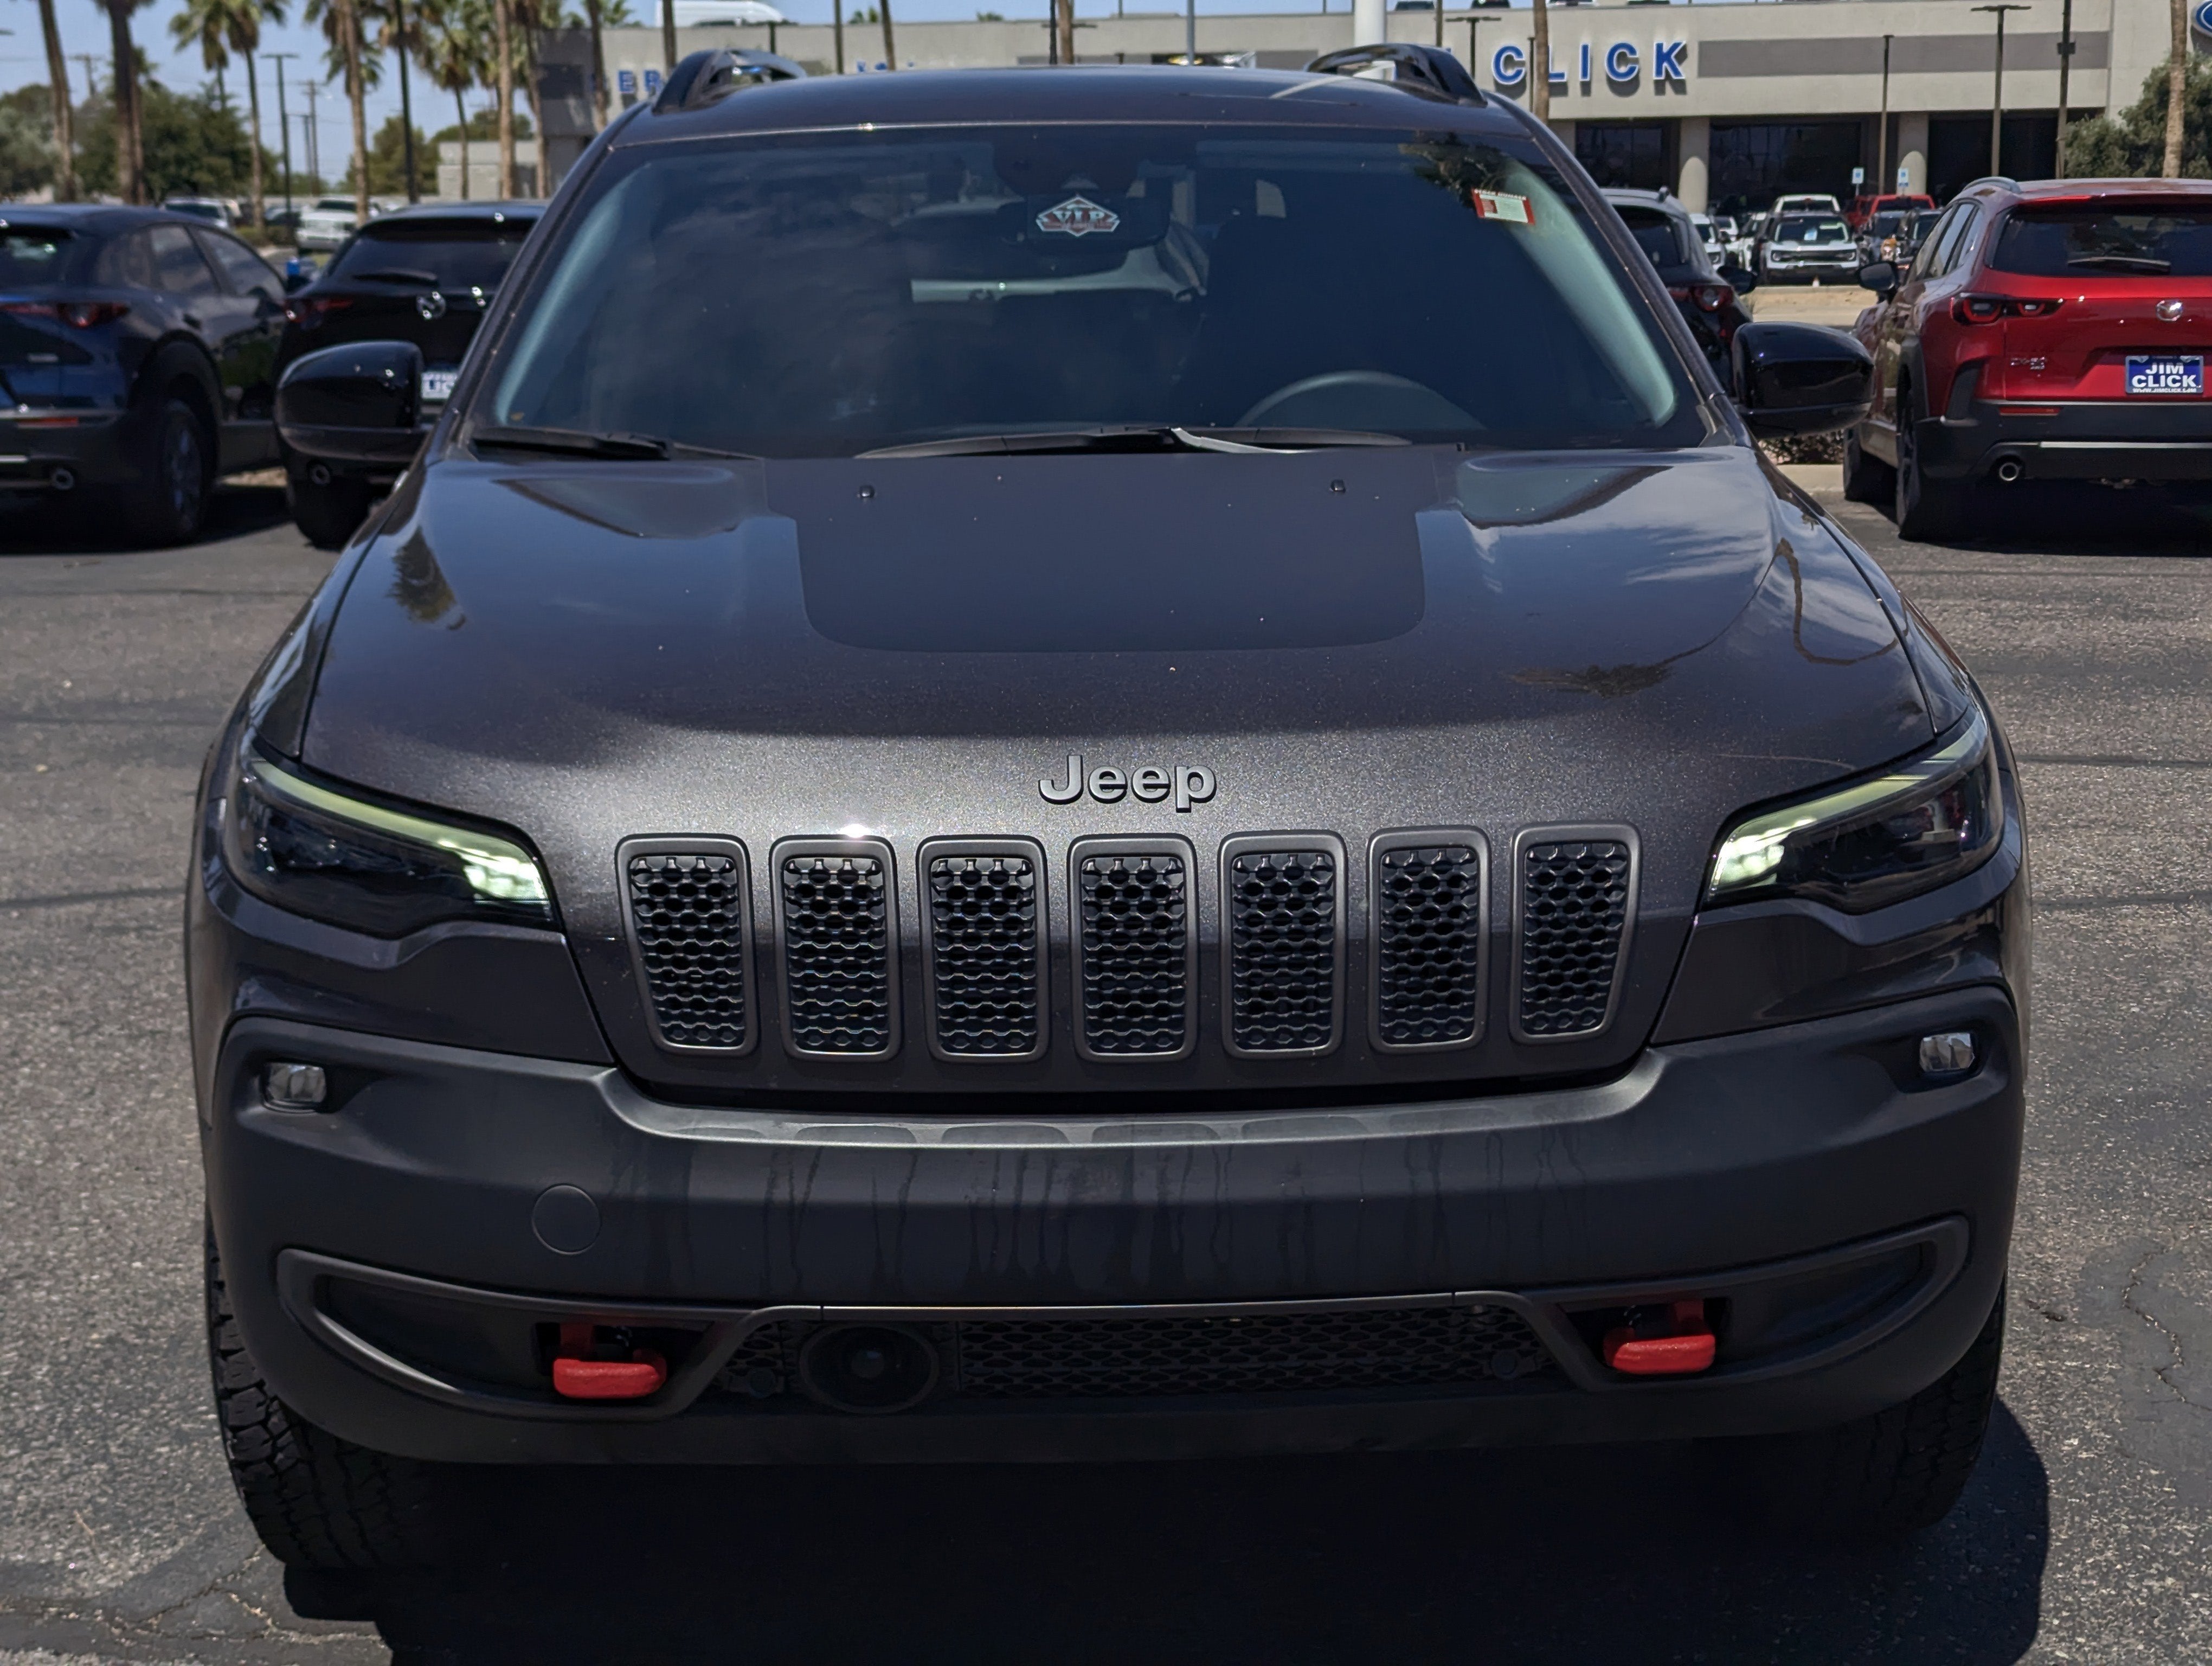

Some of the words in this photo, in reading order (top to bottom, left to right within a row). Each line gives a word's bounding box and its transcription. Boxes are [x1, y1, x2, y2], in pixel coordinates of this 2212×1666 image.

[1491, 41, 1686, 85] CLICK
[1052, 210, 1105, 223] VIP
[2145, 362, 2184, 374] JIM
[2132, 375, 2196, 388] CLICK
[1039, 754, 1217, 812] Jeep
